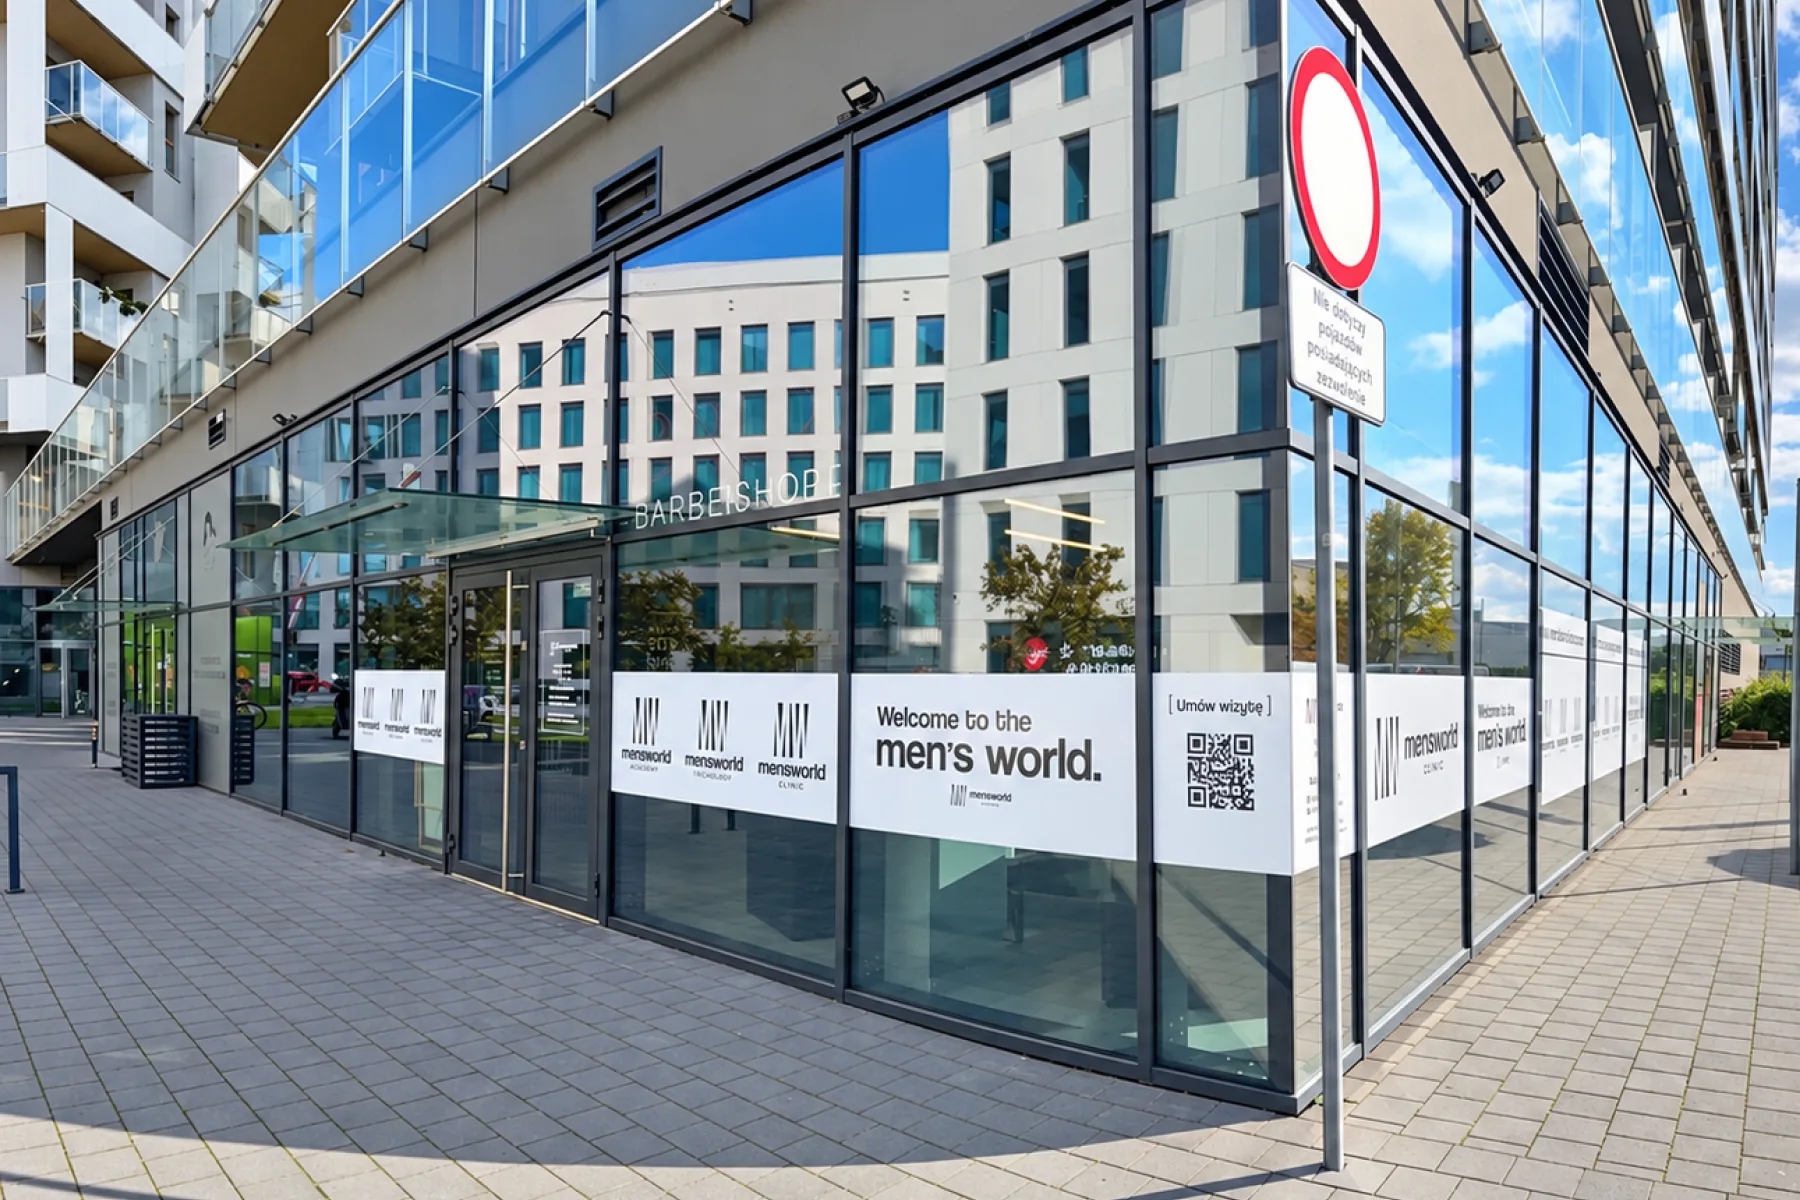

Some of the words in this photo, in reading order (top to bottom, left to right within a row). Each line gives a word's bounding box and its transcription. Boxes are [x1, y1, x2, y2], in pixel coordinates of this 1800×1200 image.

[1313, 287, 1330, 312] Nie
[1177, 698, 1216, 712] Umów
[1219, 699, 1263, 716] wizytę
[876, 706, 959, 729] Welcome
[965, 709, 989, 730] to
[996, 709, 1032, 732] the
[1404, 722, 1458, 760] mensworld
[621, 748, 672, 764] mensworld
[684, 754, 744, 771] mensworld
[876, 738, 974, 772] men's
[985, 738, 1102, 781] world.
[758, 761, 826, 781] mensworld
[778, 780, 803, 790] CLINIC
